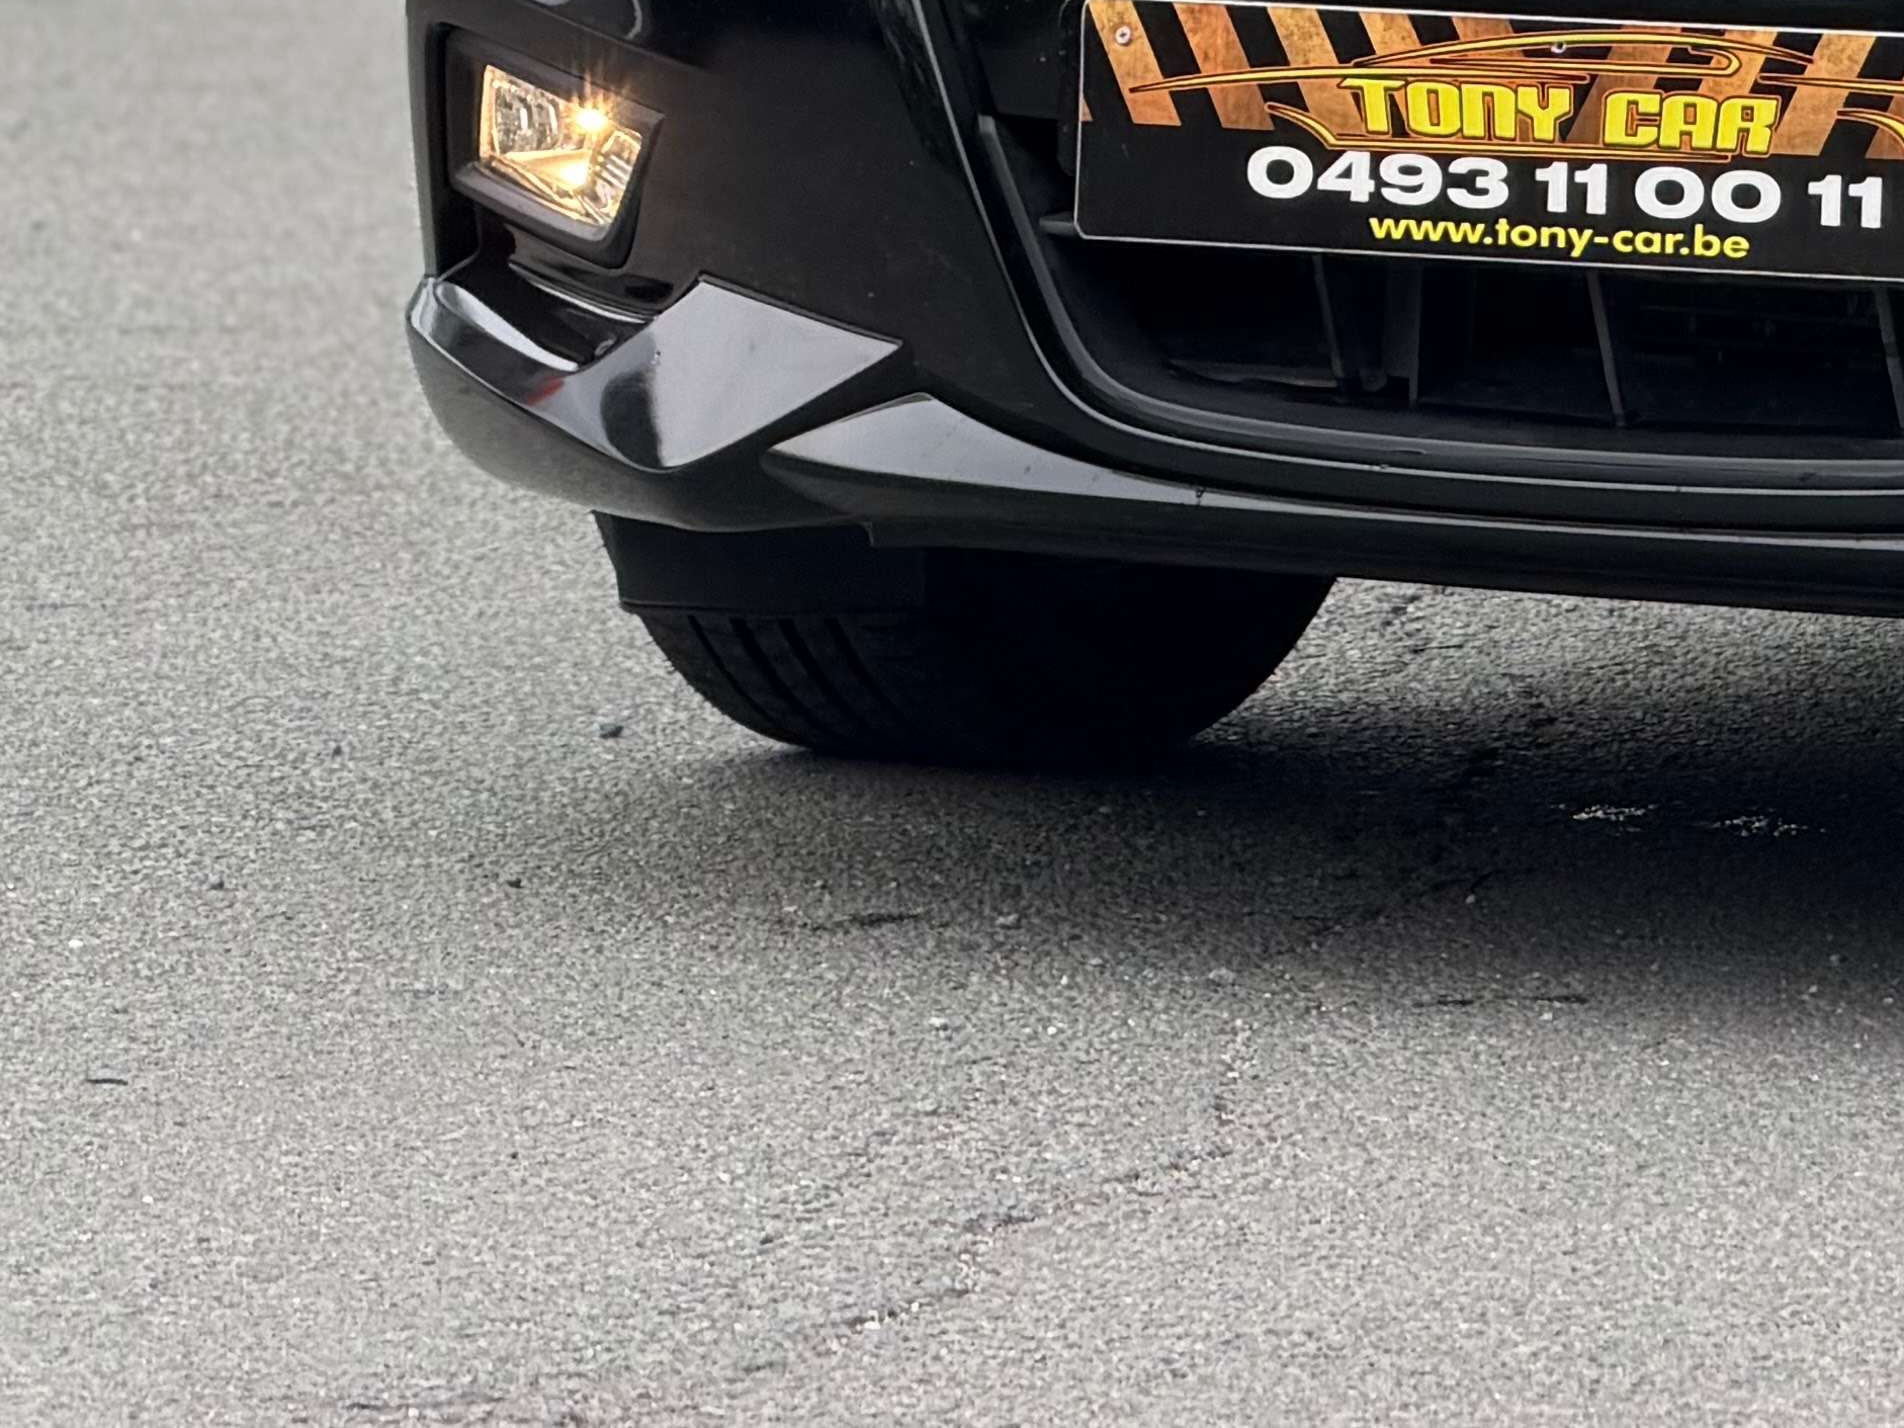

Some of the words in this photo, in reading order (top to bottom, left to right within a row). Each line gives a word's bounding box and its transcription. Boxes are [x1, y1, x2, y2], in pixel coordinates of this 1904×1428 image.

[1338, 76, 1573, 143] TONY
[1602, 90, 1776, 155] CAR
[1247, 146, 1509, 209] 0493
[1534, 162, 1607, 215] 11
[1634, 166, 1781, 223] 00
[1807, 174, 1883, 229] 11
[1369, 216, 1751, 259] www.tony-car.be
